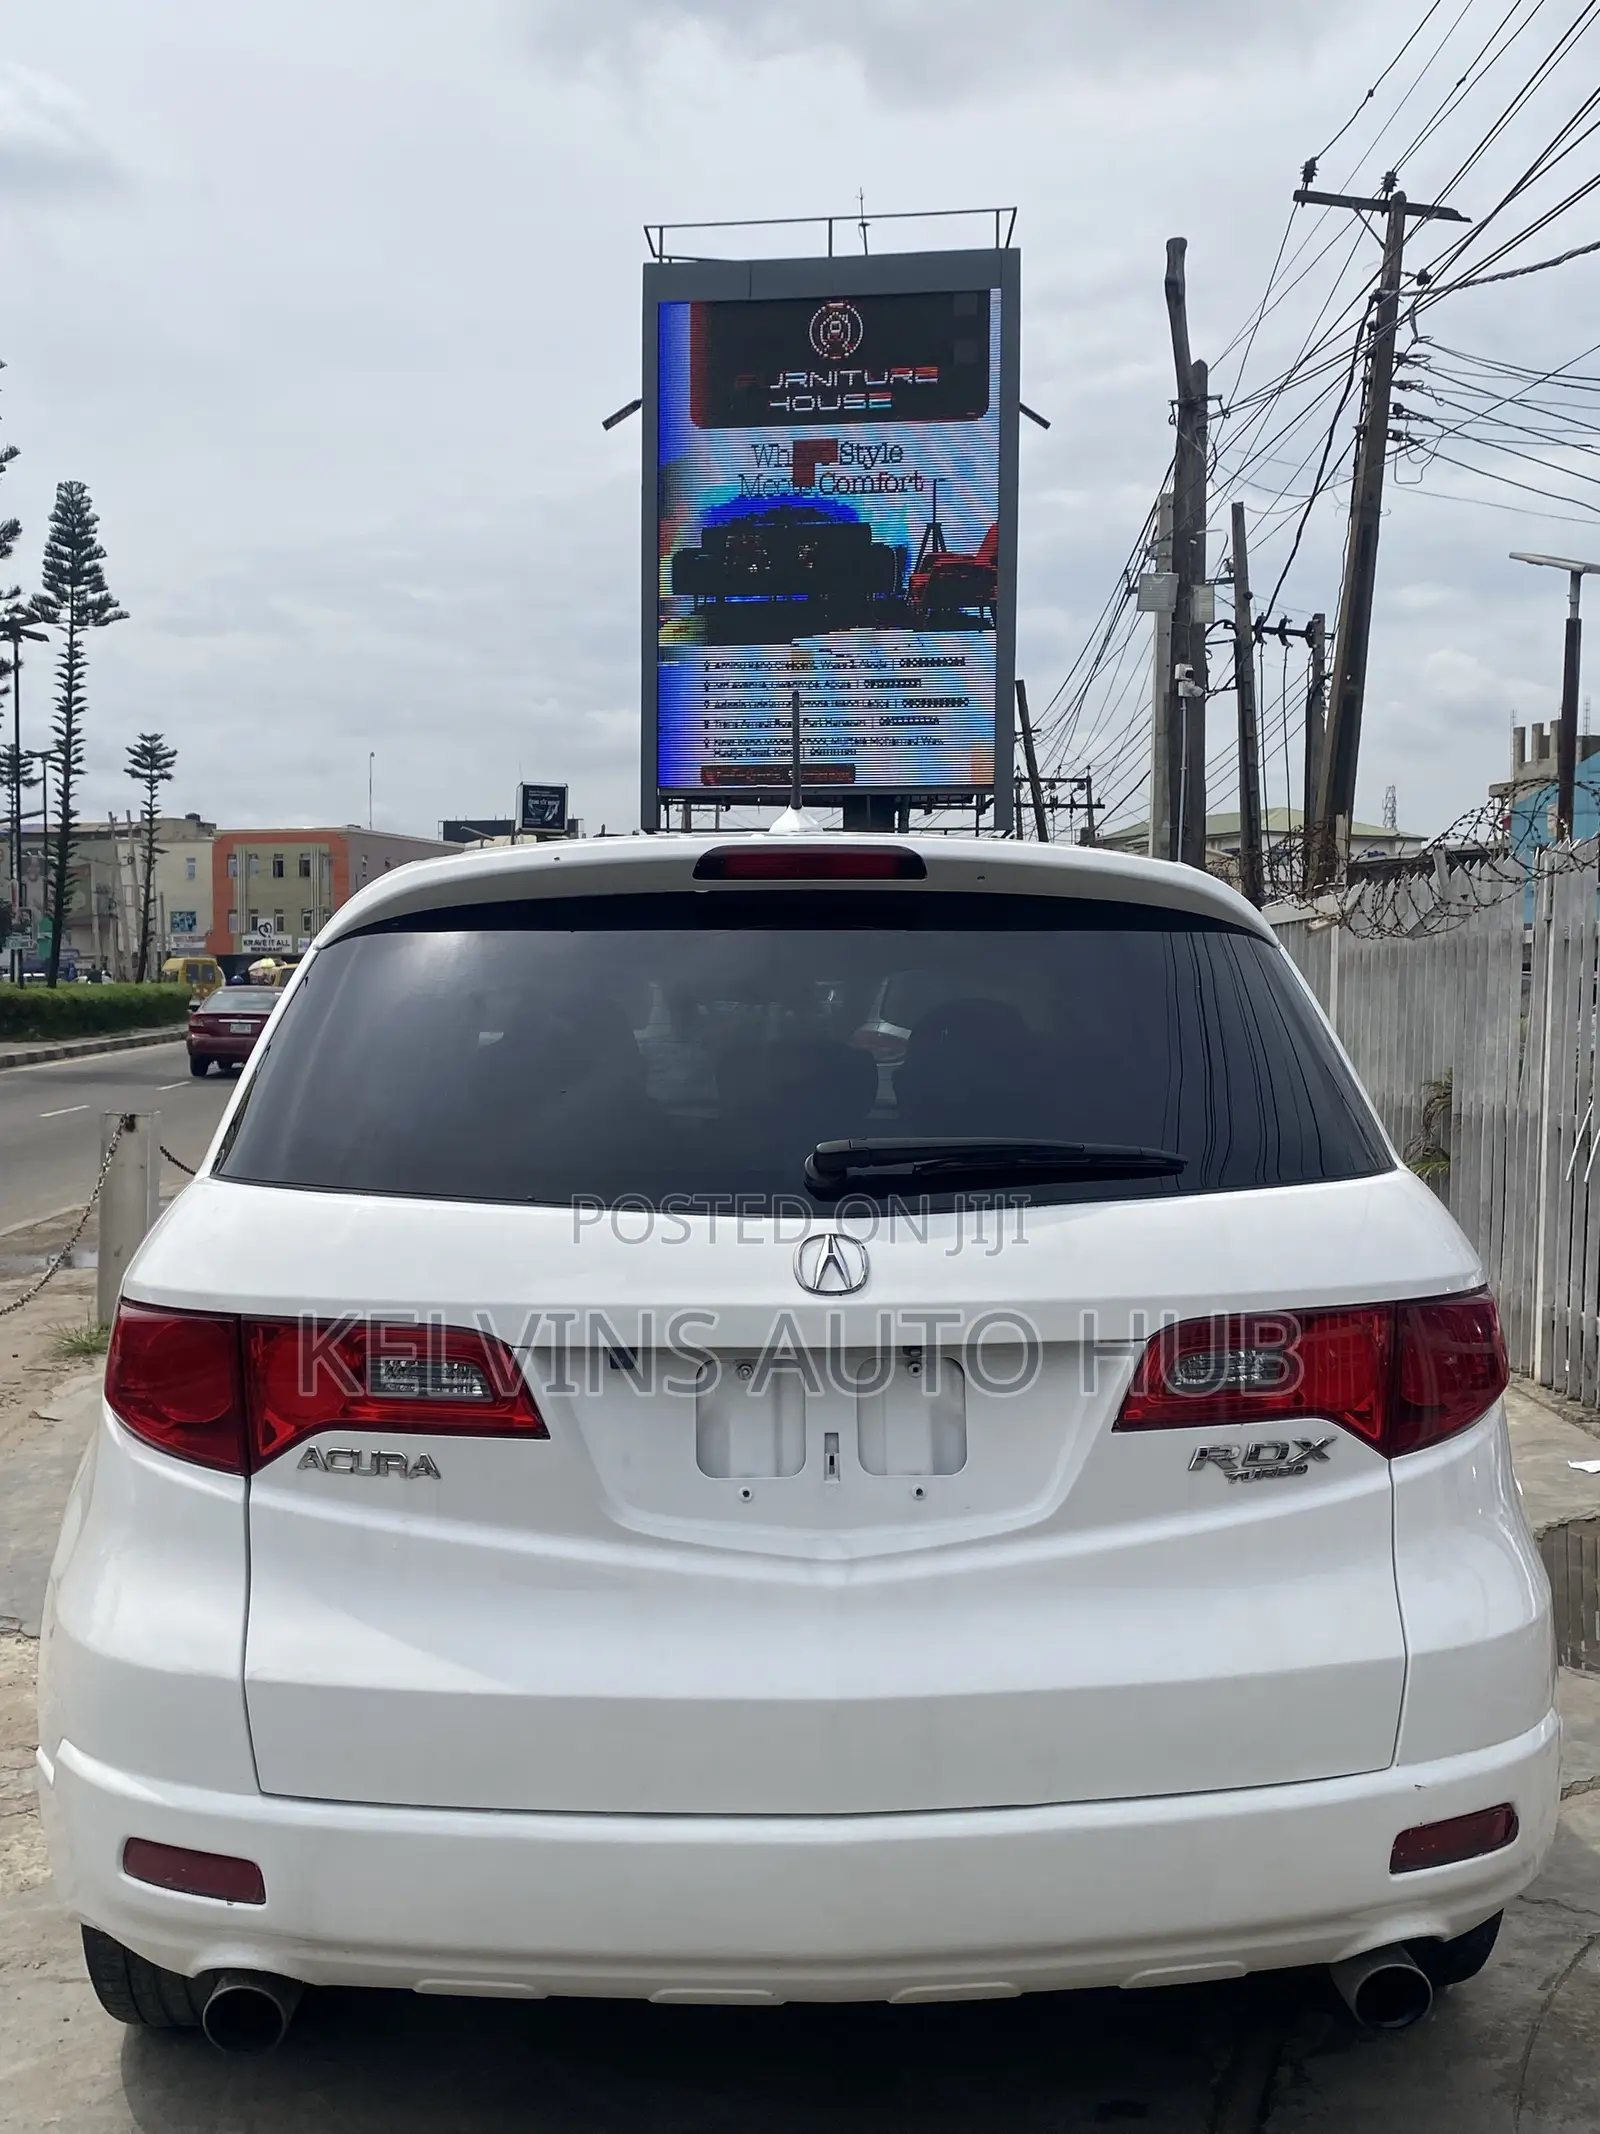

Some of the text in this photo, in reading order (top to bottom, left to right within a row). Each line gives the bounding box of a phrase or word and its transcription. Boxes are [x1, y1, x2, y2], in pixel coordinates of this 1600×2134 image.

[839, 441, 903, 470] Style
[818, 470, 924, 496] Comfort
[276, 939, 290, 947] ALL
[297, 1445, 442, 1480] ACURA
[1188, 1436, 1338, 1471] RDX
[1224, 1464, 1309, 1484] TURBO
